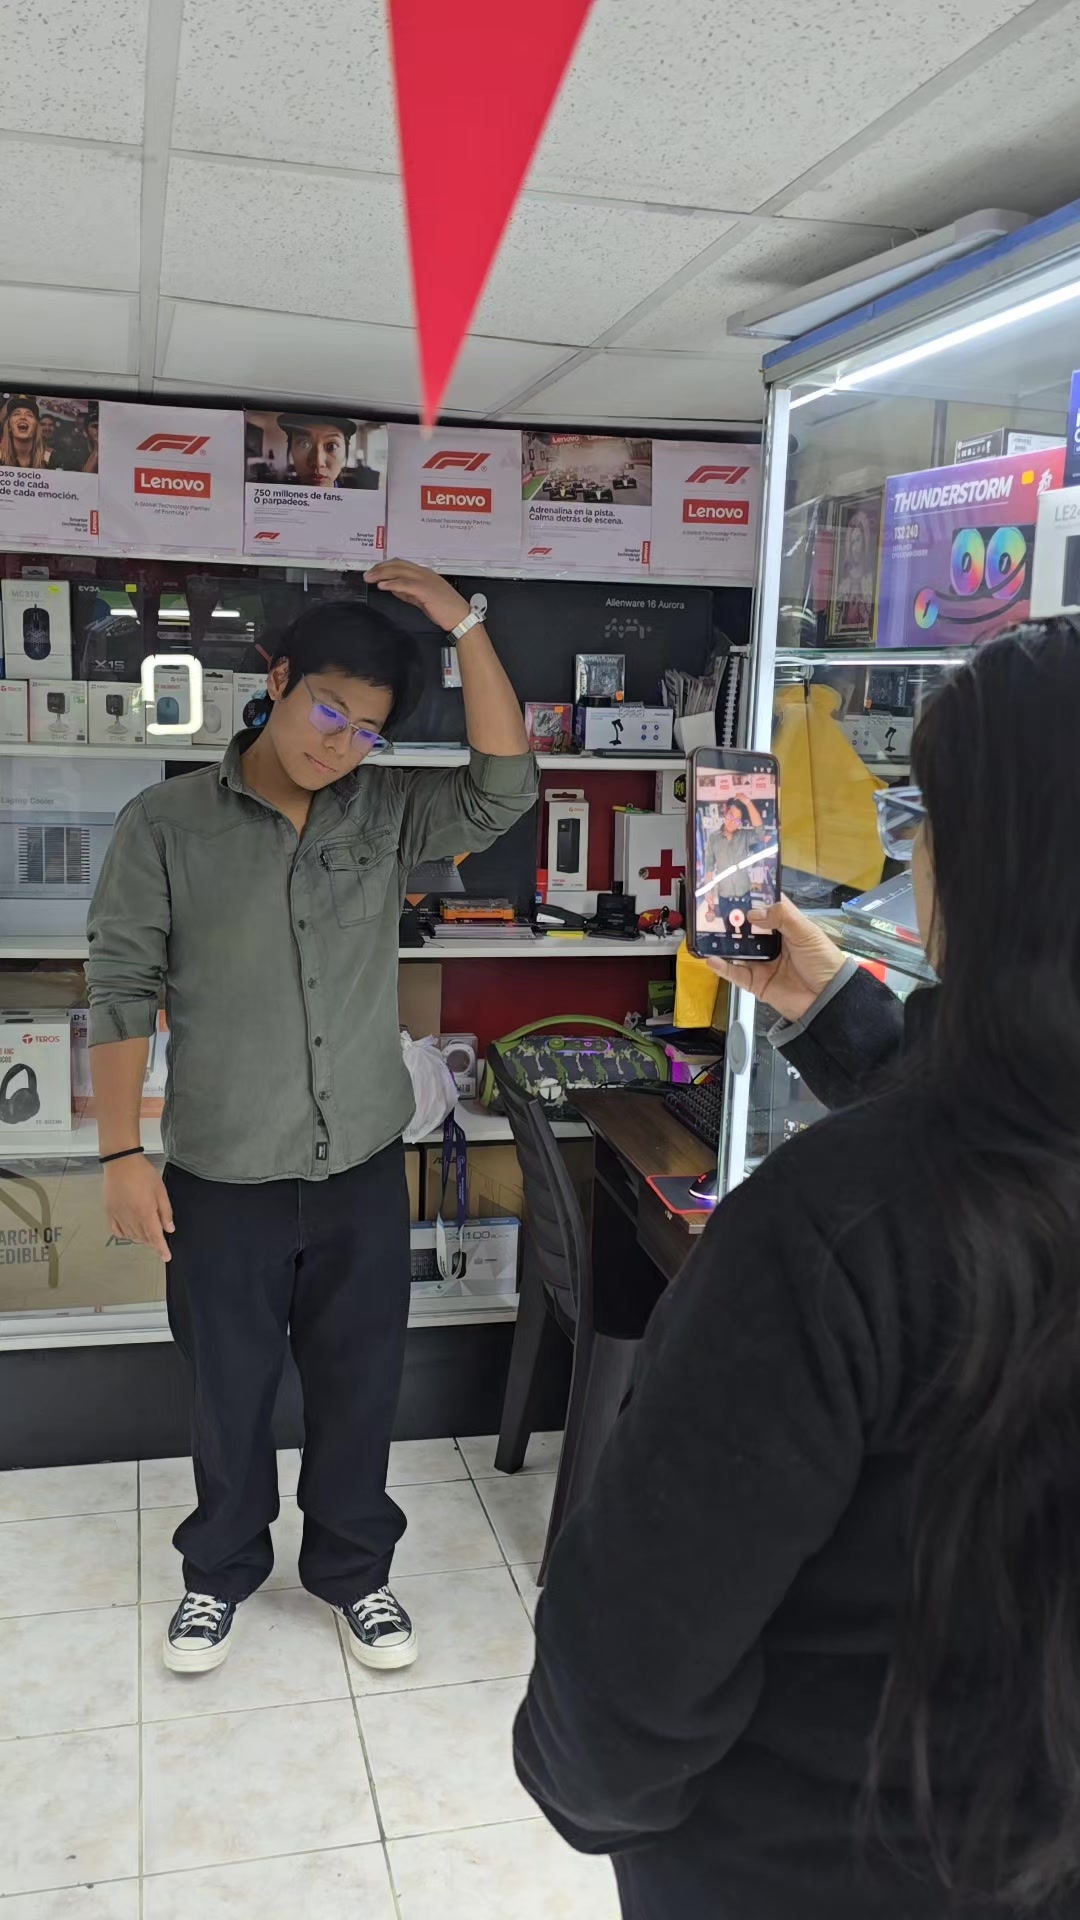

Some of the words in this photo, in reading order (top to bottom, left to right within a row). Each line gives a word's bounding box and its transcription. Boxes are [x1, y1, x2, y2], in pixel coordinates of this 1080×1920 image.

[17, 471, 41, 480] socio
[141, 472, 205, 492] Lenovo
[13, 479, 25, 488] de
[27, 481, 50, 489] cada
[0, 487, 11, 495] de
[13, 489, 36, 497] cada
[38, 491, 79, 501] emoción.
[254, 488, 271, 497] 750
[273, 489, 309, 499] millones
[310, 491, 321, 500] de
[323, 492, 343, 501] fans.
[427, 490, 486, 507] Lenovo
[894, 475, 1014, 513] THUNDERSTORM
[159, 502, 189, 511] Technology
[262, 498, 310, 507] parpadeos.
[529, 505, 573, 515] Adrenalina
[574, 508, 584, 516] en
[585, 508, 593, 517] la
[594, 509, 616, 518] pista.
[688, 503, 744, 519] Lenovo
[529, 513, 555, 522] Calma
[556, 514, 581, 523] detrás
[582, 515, 593, 523] de
[594, 516, 624, 525] escena.
[906, 523, 919, 539] 240
[12, 590, 39, 598] MC310
[605, 598, 645, 608] Alienware
[648, 600, 656, 608] 16
[658, 600, 685, 609] Aurora
[95, 659, 125, 669] X15
[35, 1035, 60, 1043] TEROS
[0, 1229, 39, 1246] ARCH
[44, 1226, 63, 1243] OF
[0, 1246, 50, 1265] EDIBLE
